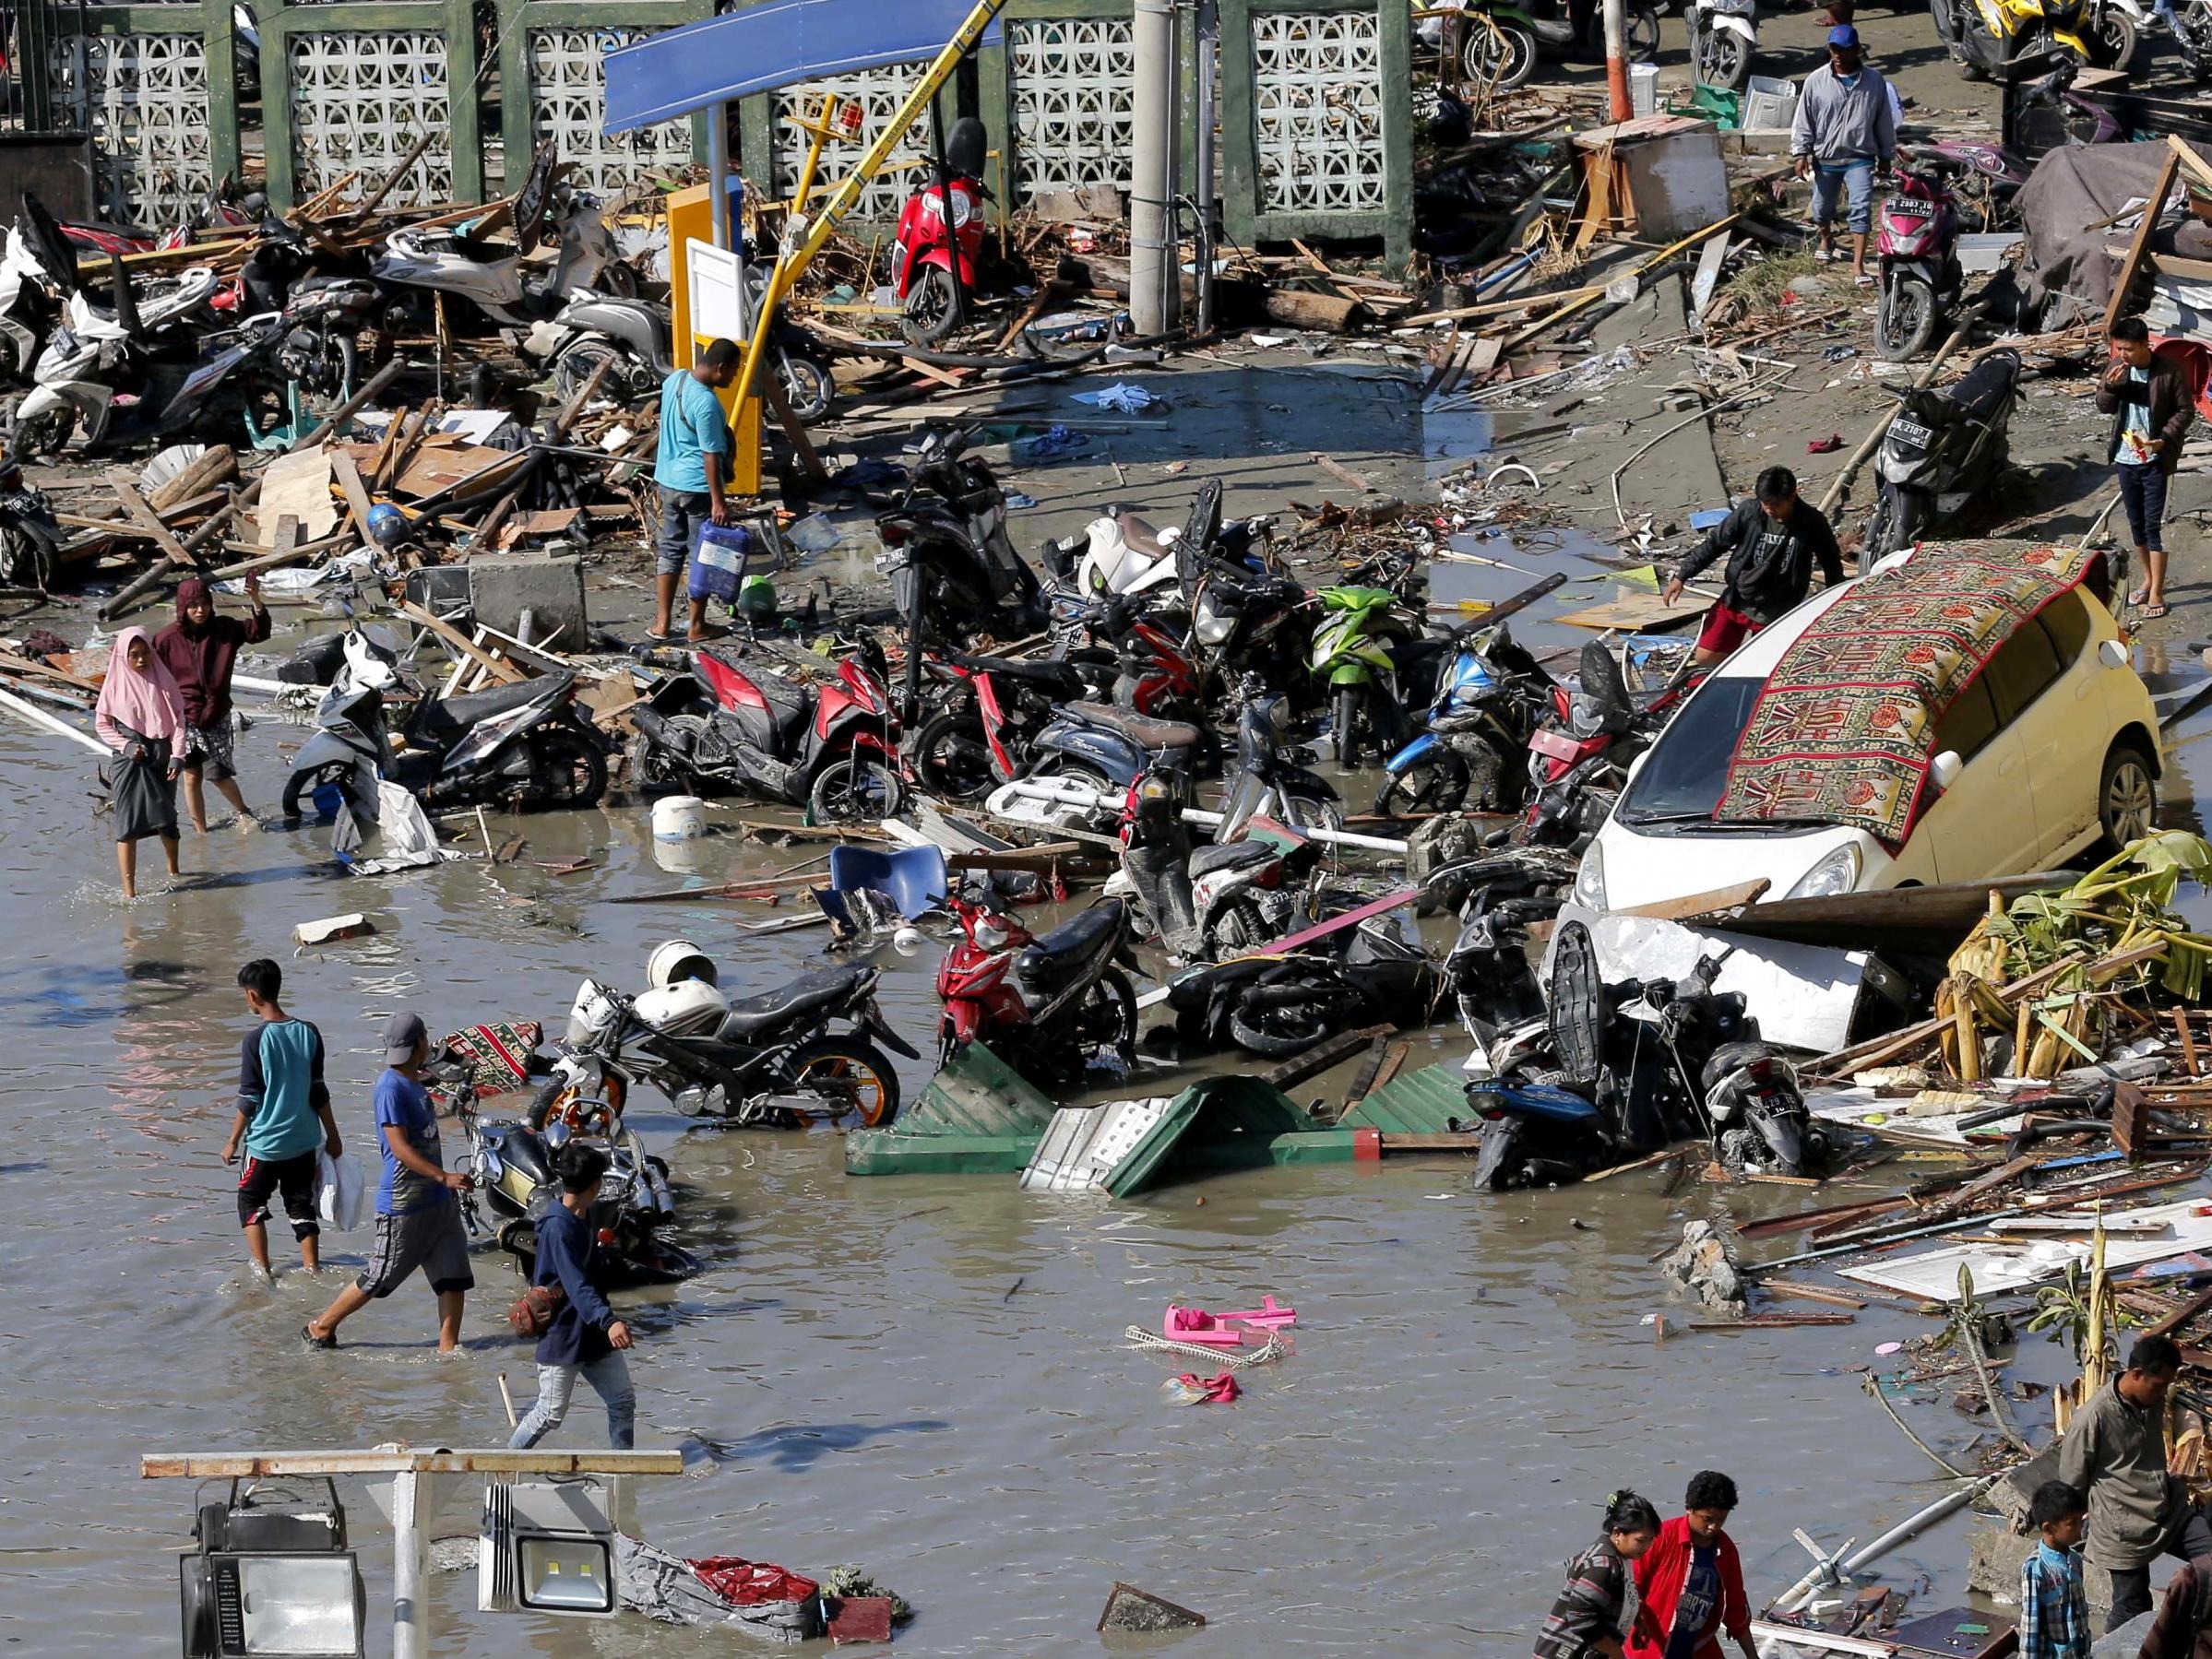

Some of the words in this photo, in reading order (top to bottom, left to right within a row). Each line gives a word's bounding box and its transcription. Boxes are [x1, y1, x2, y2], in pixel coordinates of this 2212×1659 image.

[886, 103, 915, 142] DILARANG
[909, 81, 933, 111] MASUK
[1904, 424, 1924, 434] 2107
